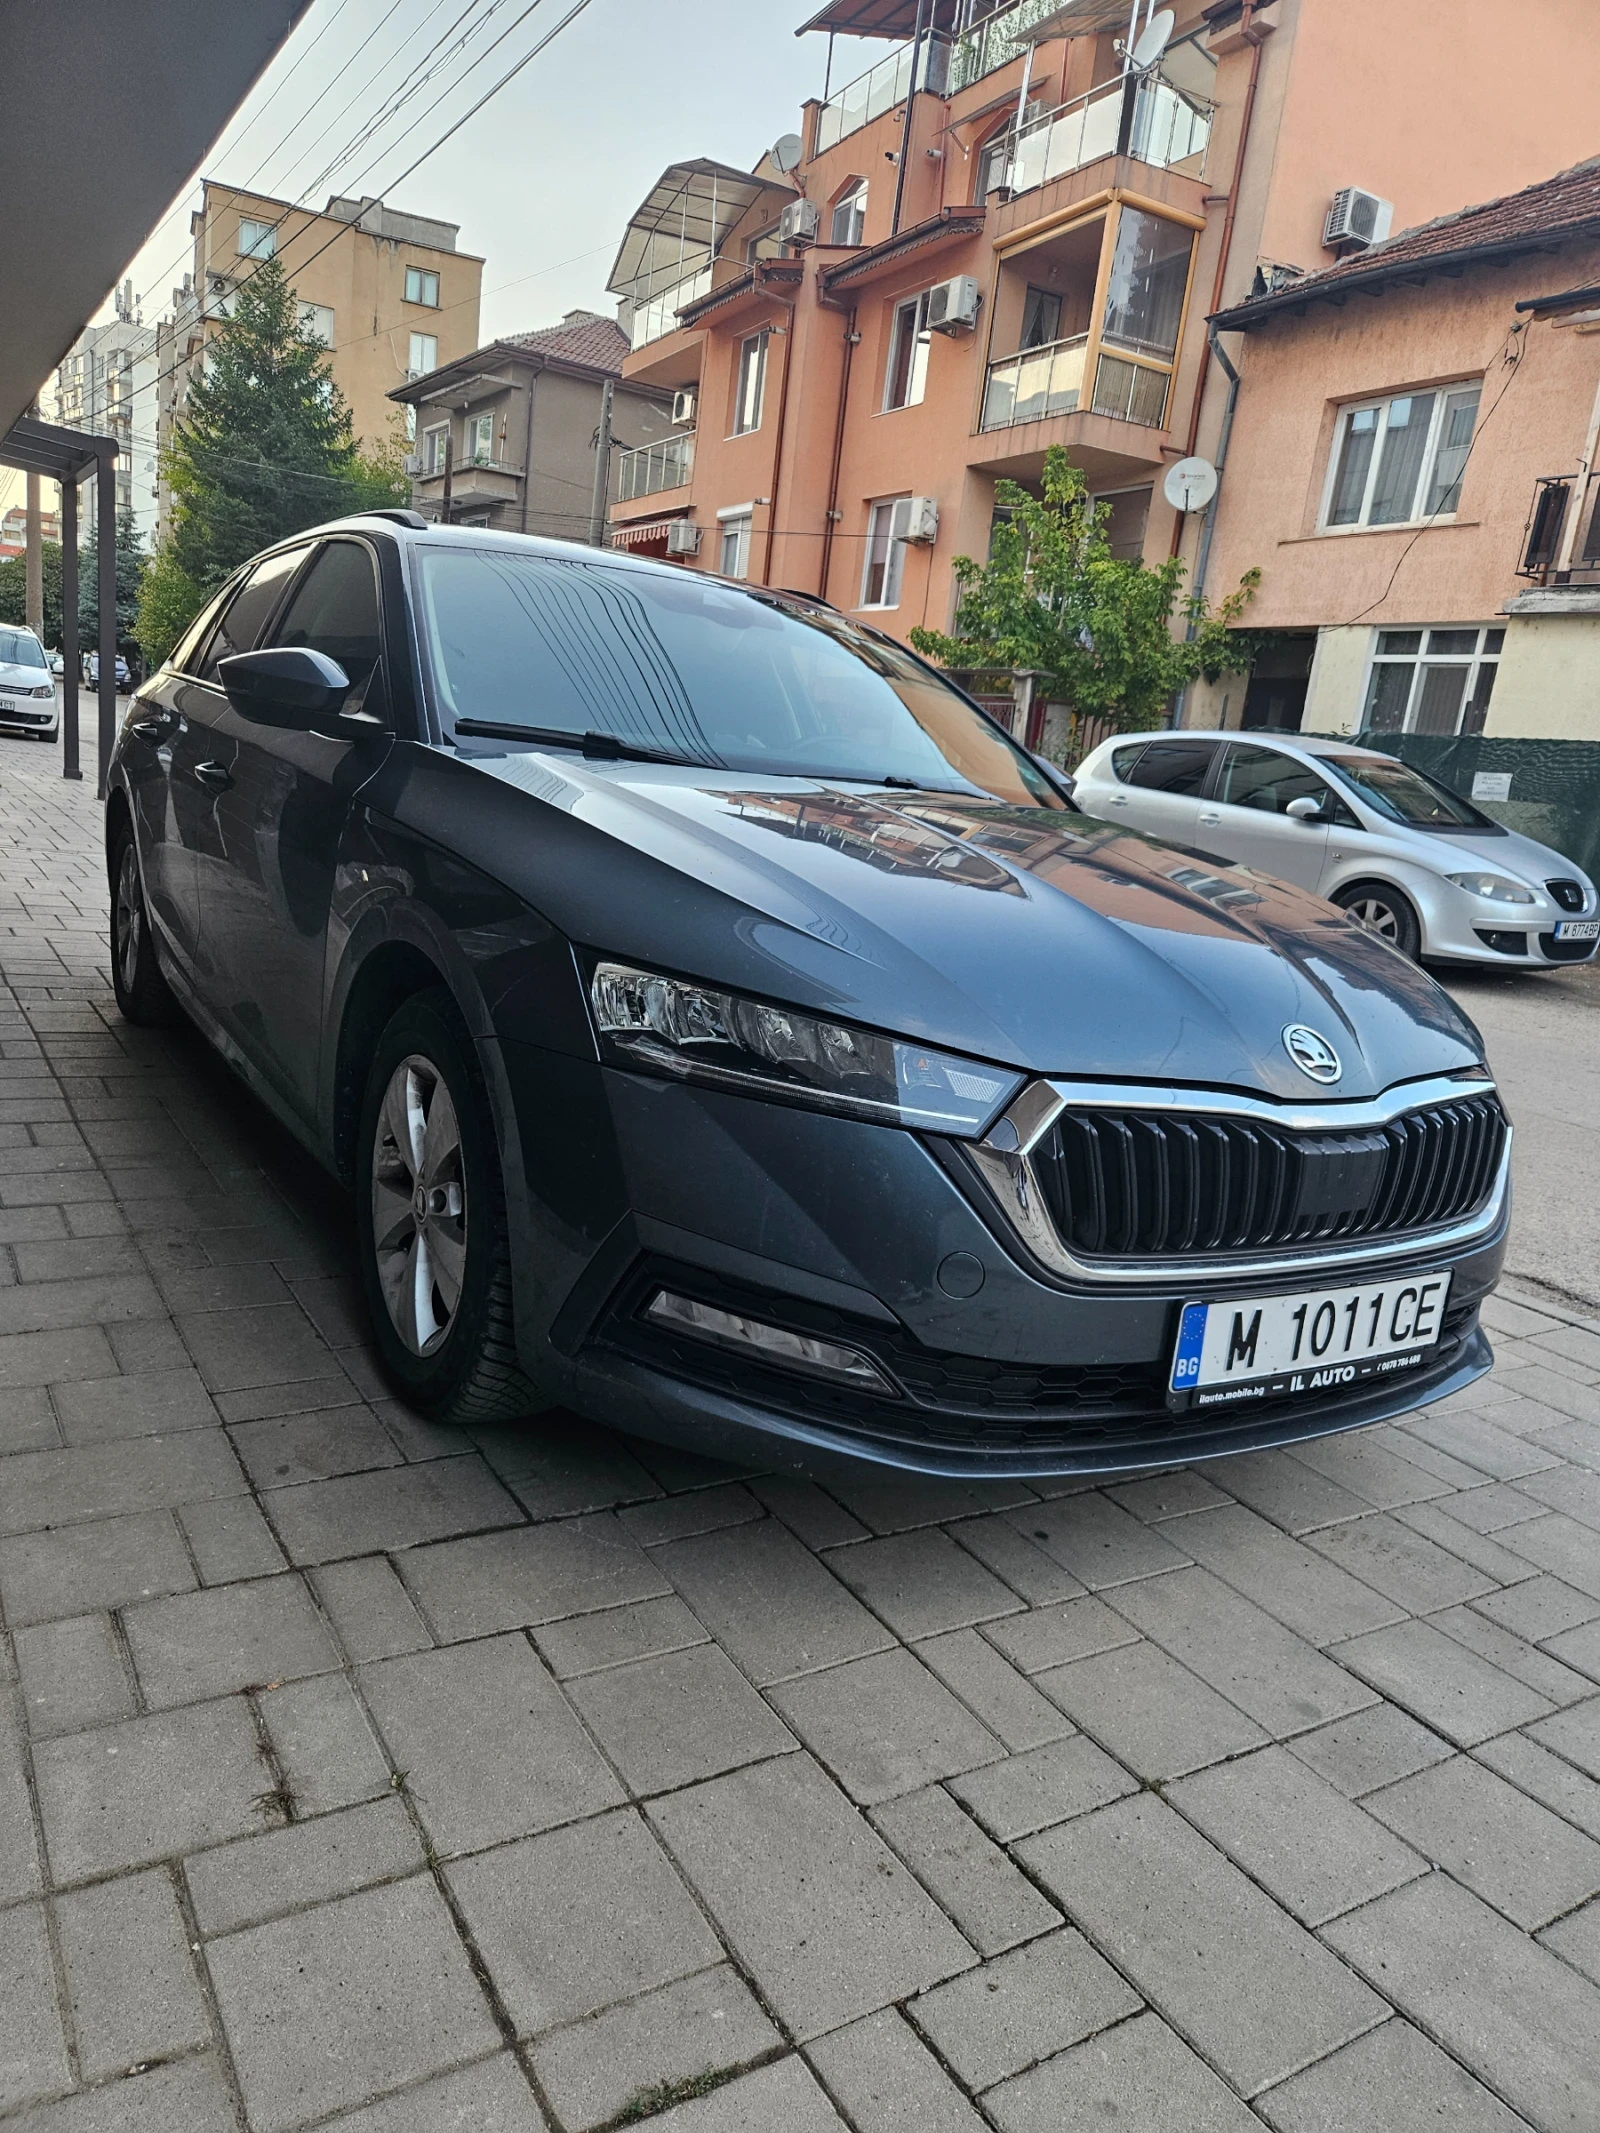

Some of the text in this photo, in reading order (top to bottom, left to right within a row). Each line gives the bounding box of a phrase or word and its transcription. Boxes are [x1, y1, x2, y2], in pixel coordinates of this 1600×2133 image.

[1226, 1309, 1263, 1371] M
[1176, 1357, 1199, 1378] BG
[1290, 1365, 1356, 1392] IL AUTO
